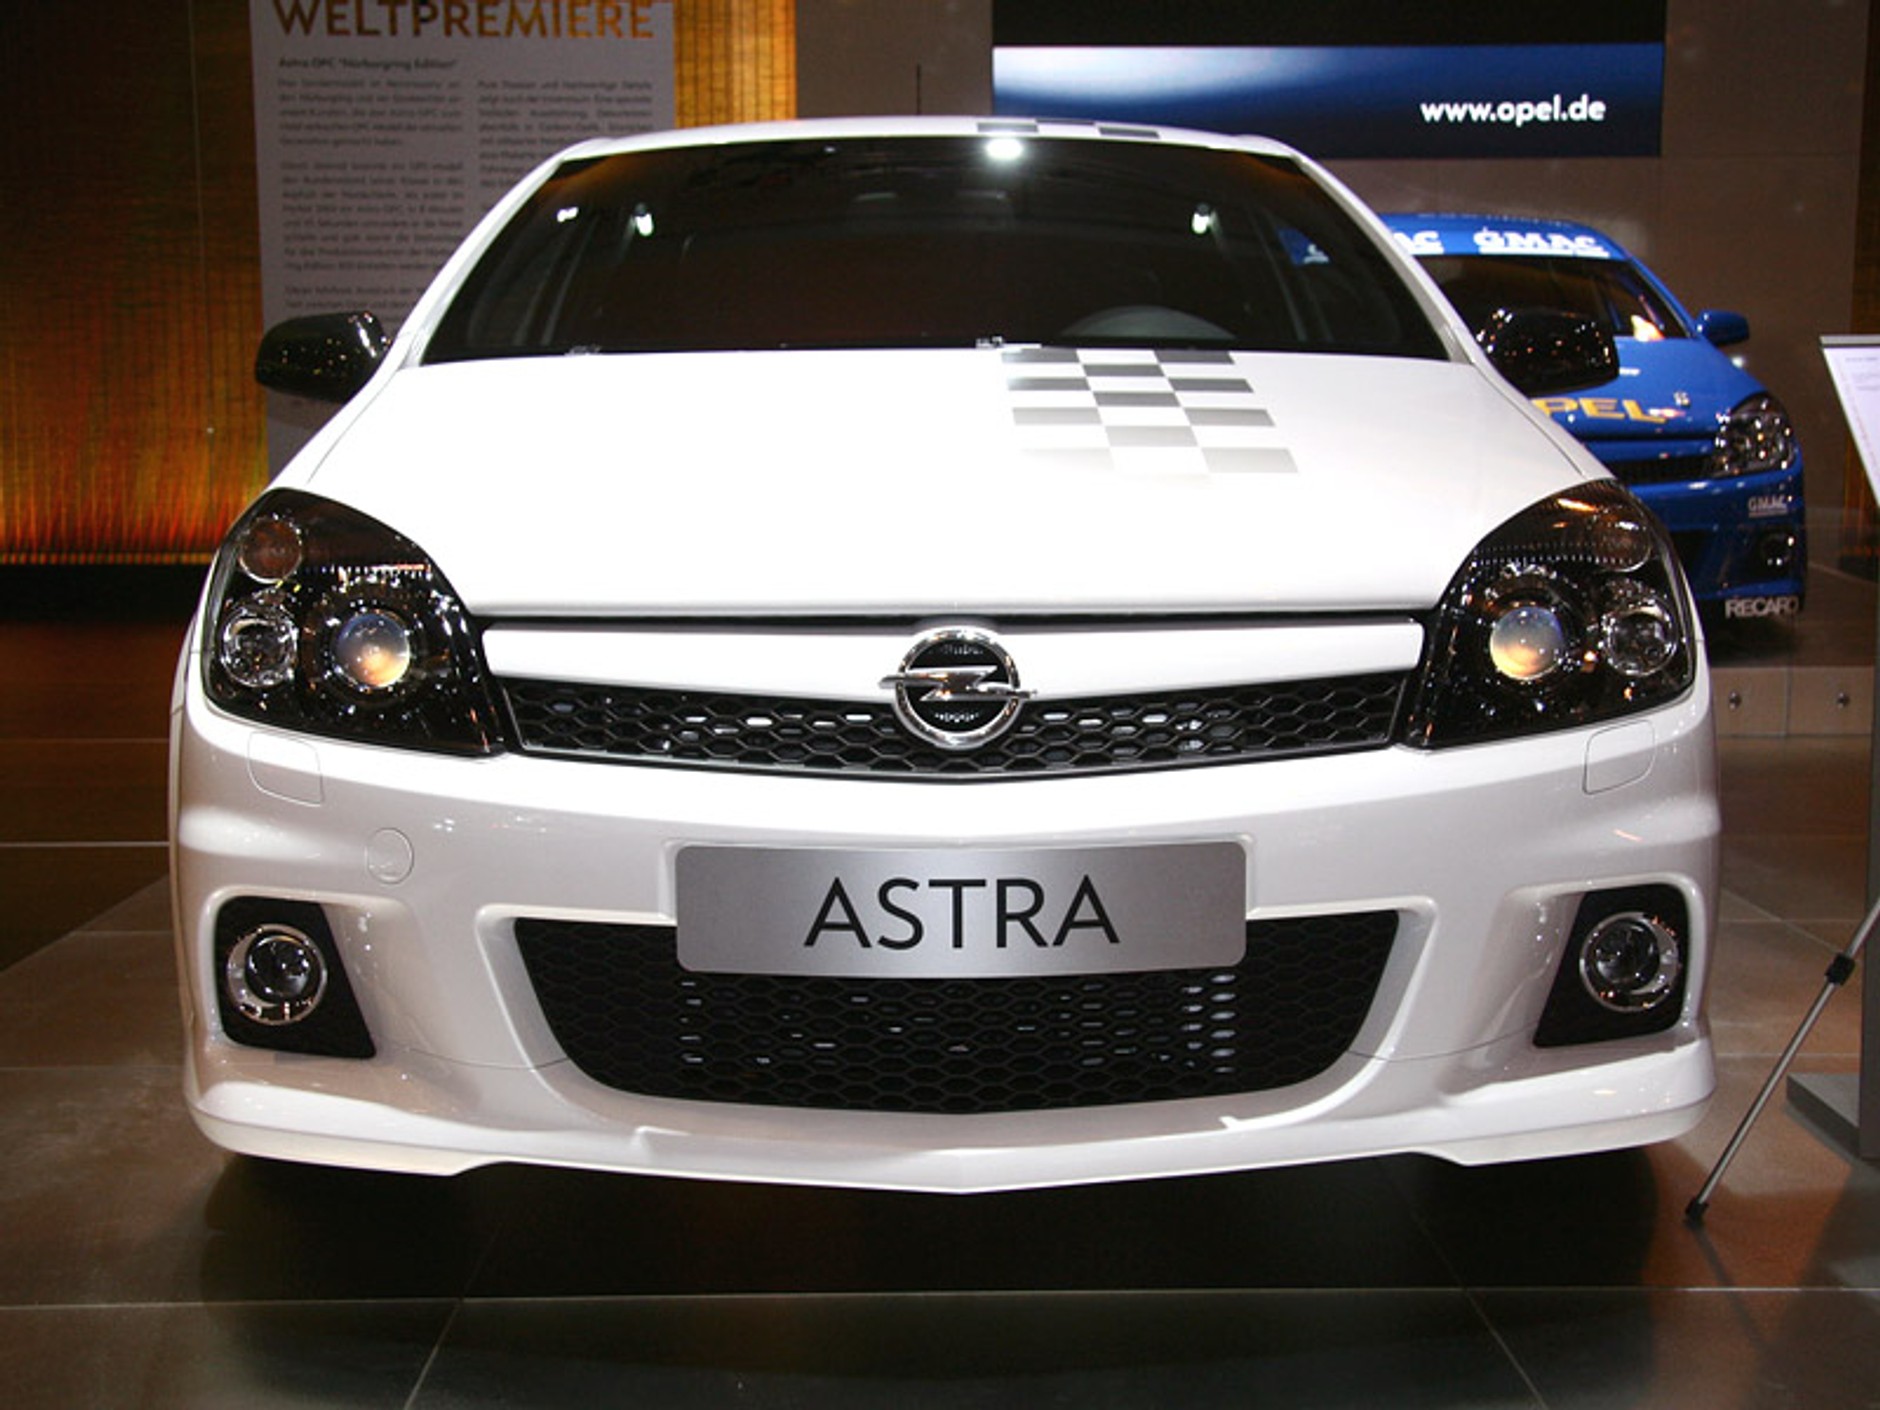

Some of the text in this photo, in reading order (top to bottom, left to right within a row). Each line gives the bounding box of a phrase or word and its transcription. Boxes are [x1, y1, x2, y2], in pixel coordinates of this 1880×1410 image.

[272, 0, 656, 38] WELTPREMIERE
[311, 56, 334, 69] OPC
[1420, 93, 1606, 128] www.opel.de
[1473, 226, 1603, 250] GMAC
[1725, 596, 1799, 618] RECARO
[804, 875, 1120, 950] ASTRA
